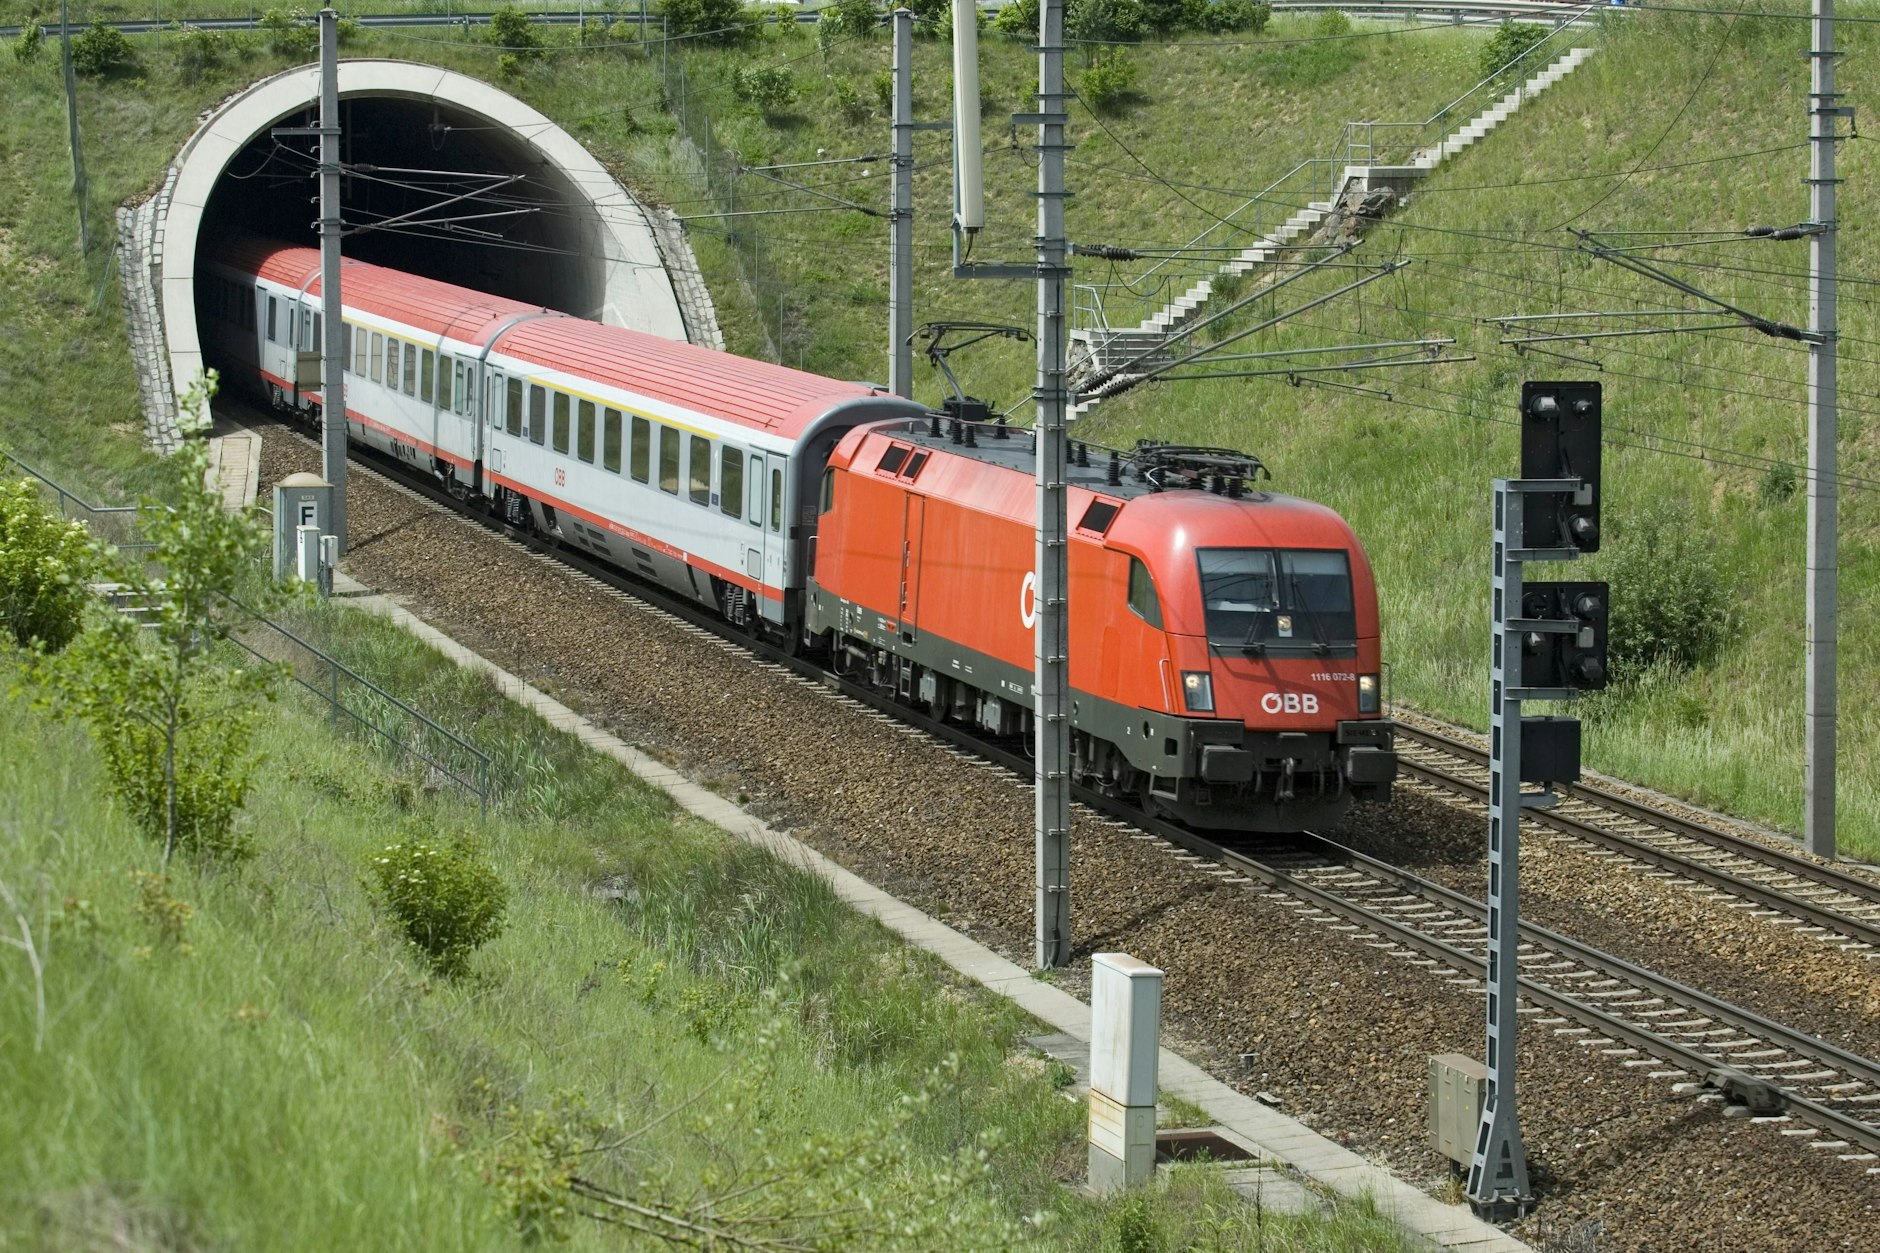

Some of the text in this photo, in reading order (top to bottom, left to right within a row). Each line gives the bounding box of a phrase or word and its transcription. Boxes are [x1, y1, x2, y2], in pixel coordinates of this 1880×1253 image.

[301, 506, 315, 526] F
[1310, 672, 1356, 682] 1116 072-8
[1260, 692, 1320, 715] ÖBB
